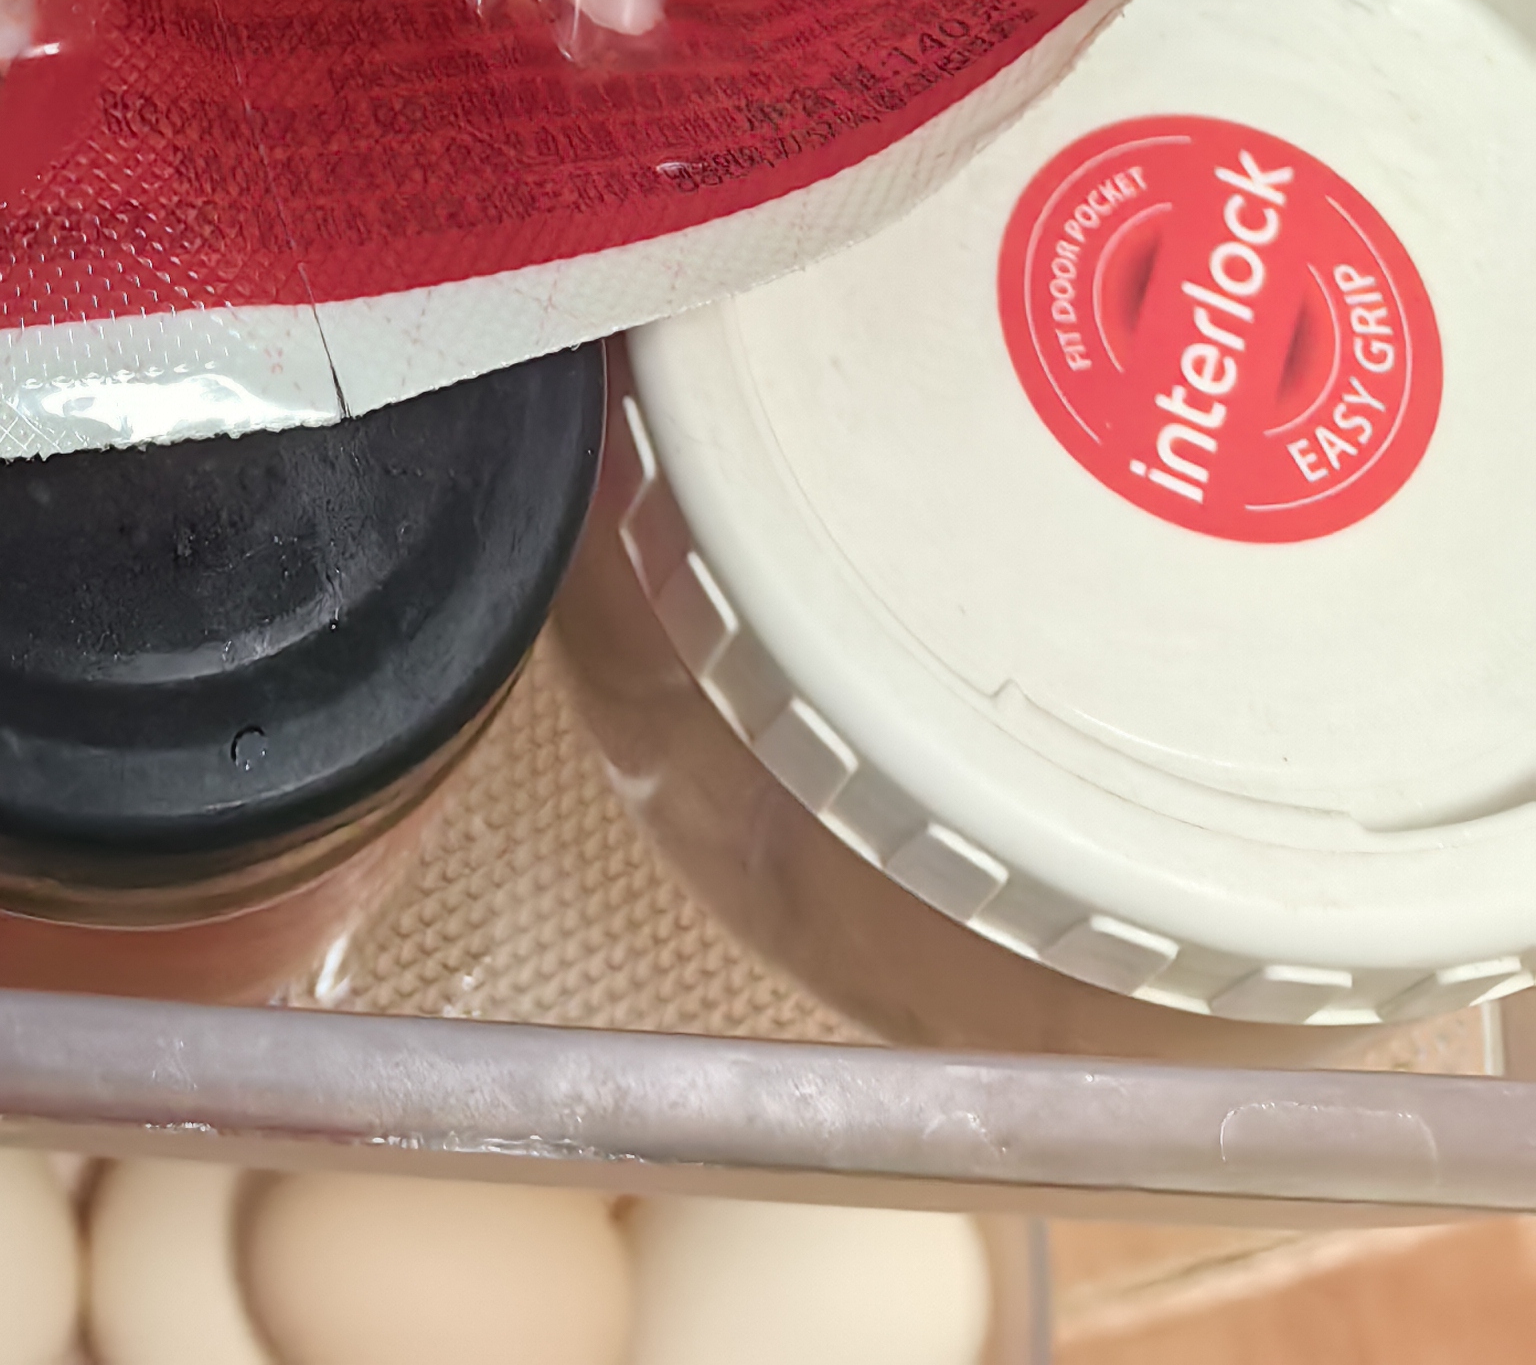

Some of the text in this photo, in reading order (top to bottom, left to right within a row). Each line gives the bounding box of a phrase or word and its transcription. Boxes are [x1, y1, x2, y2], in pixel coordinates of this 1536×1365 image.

[1049, 164, 1149, 372] FIT DOOR POCKET
[1129, 148, 1295, 504] interlock
[1285, 262, 1396, 484] EASY GRIP
